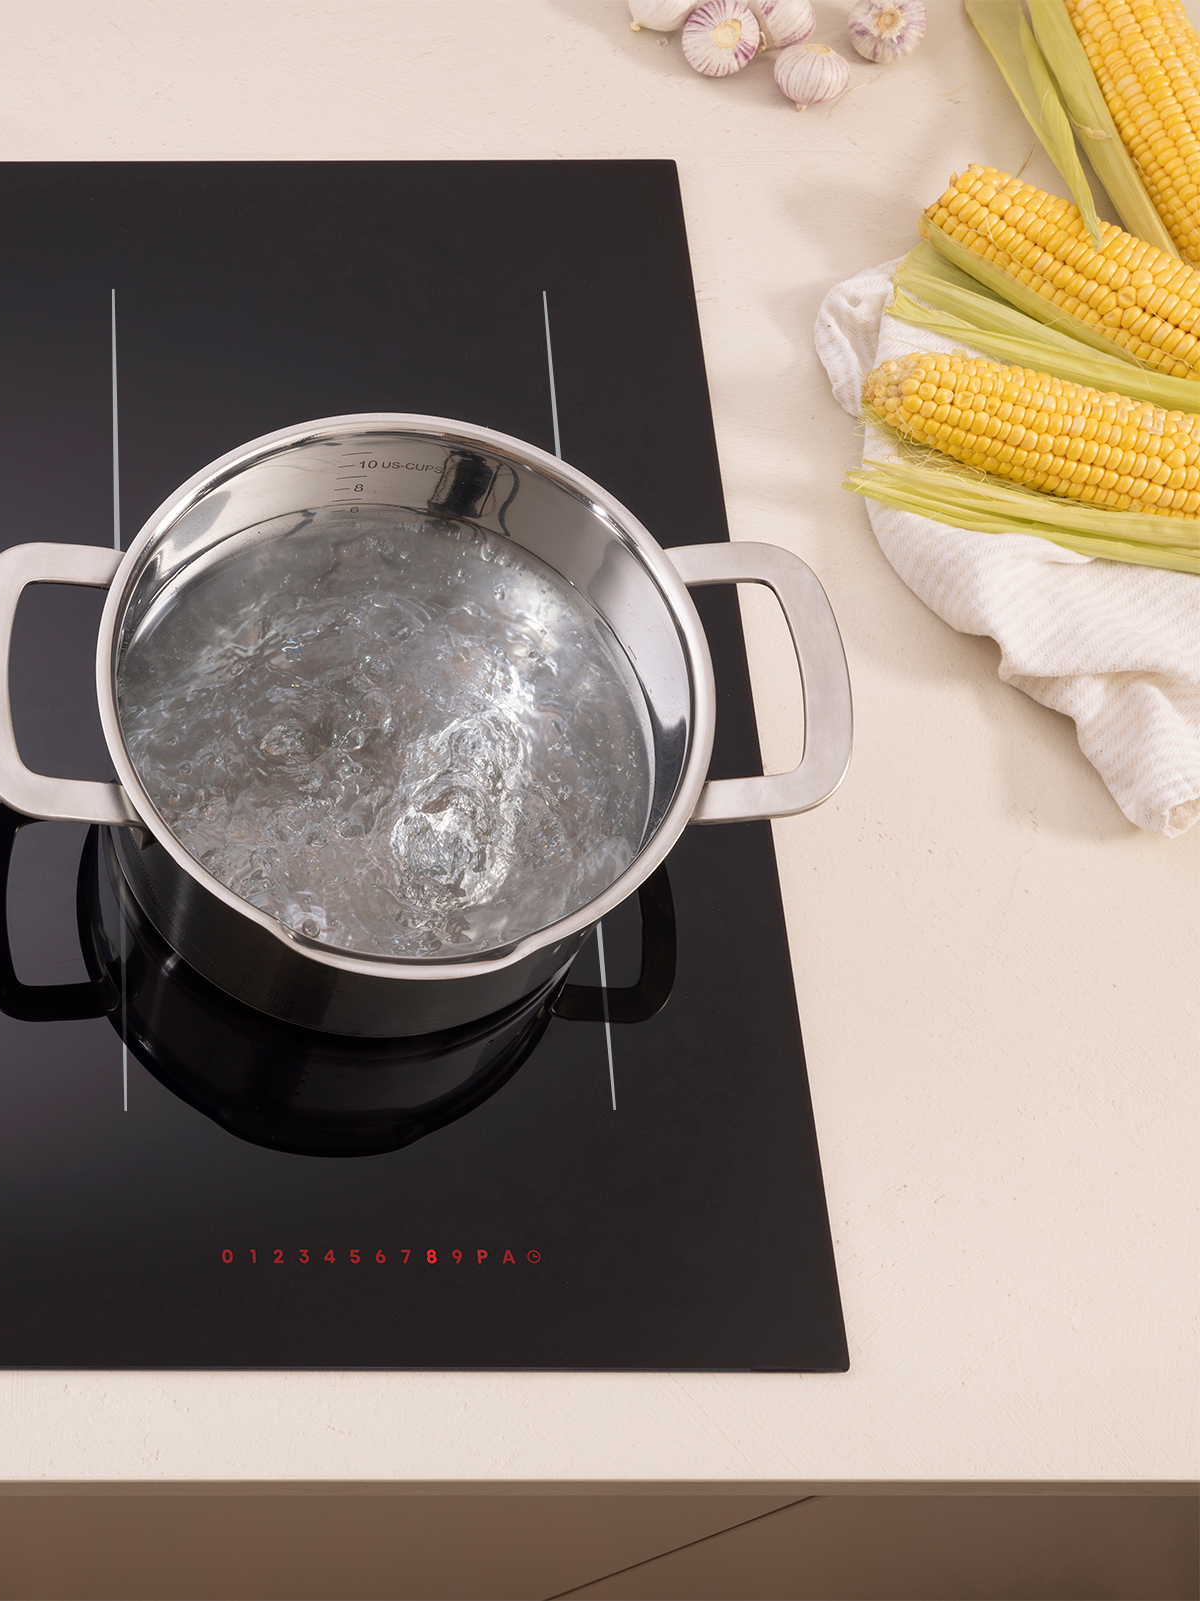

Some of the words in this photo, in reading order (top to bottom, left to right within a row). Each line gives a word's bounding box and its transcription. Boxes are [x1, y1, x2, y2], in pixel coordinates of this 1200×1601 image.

[358, 460, 378, 469] 10
[381, 461, 444, 474] US-CUPS
[353, 484, 364, 492] 8
[221, 1248, 234, 1264] 0
[249, 1248, 257, 1264] 1
[273, 1248, 285, 1264] 2
[298, 1248, 310, 1264] 3
[323, 1248, 336, 1264] 4
[349, 1248, 361, 1264] 5
[375, 1248, 387, 1264] 6
[400, 1248, 411, 1264] 7
[426, 1248, 438, 1265] 8
[451, 1248, 463, 1265] 9
[476, 1248, 489, 1265] P
[502, 1248, 516, 1265] A
